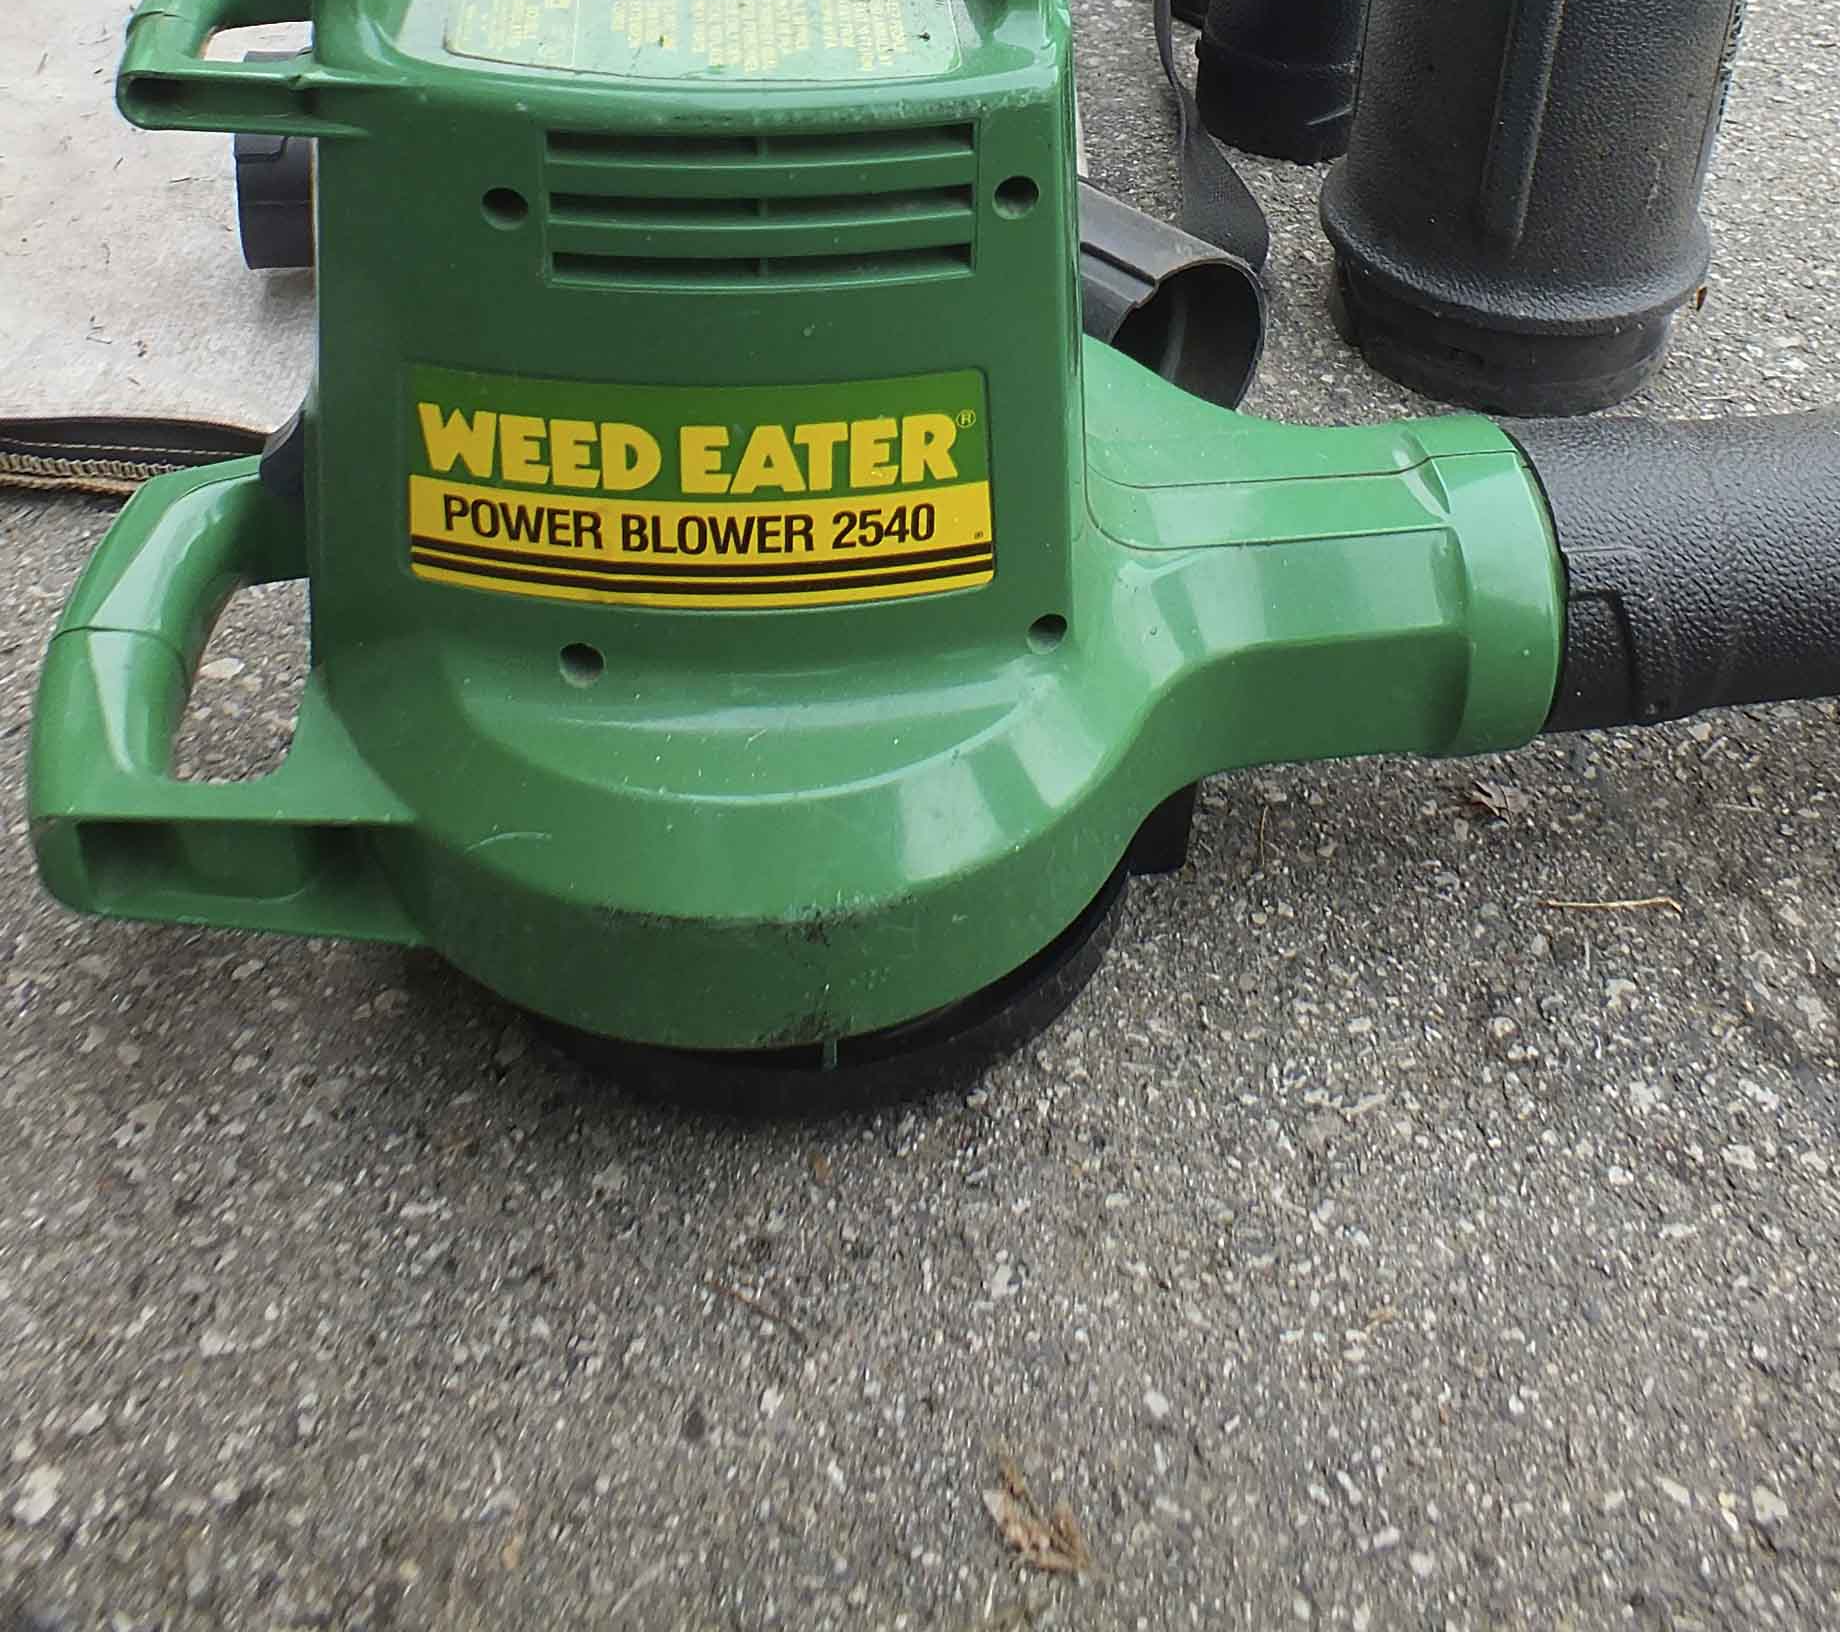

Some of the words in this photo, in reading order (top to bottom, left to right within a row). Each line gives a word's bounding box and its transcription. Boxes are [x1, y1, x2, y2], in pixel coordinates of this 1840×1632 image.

[417, 401, 662, 492] WEED
[442, 493, 604, 550] POWER
[620, 513, 815, 556] BLOWER
[831, 502, 936, 550] 2540
